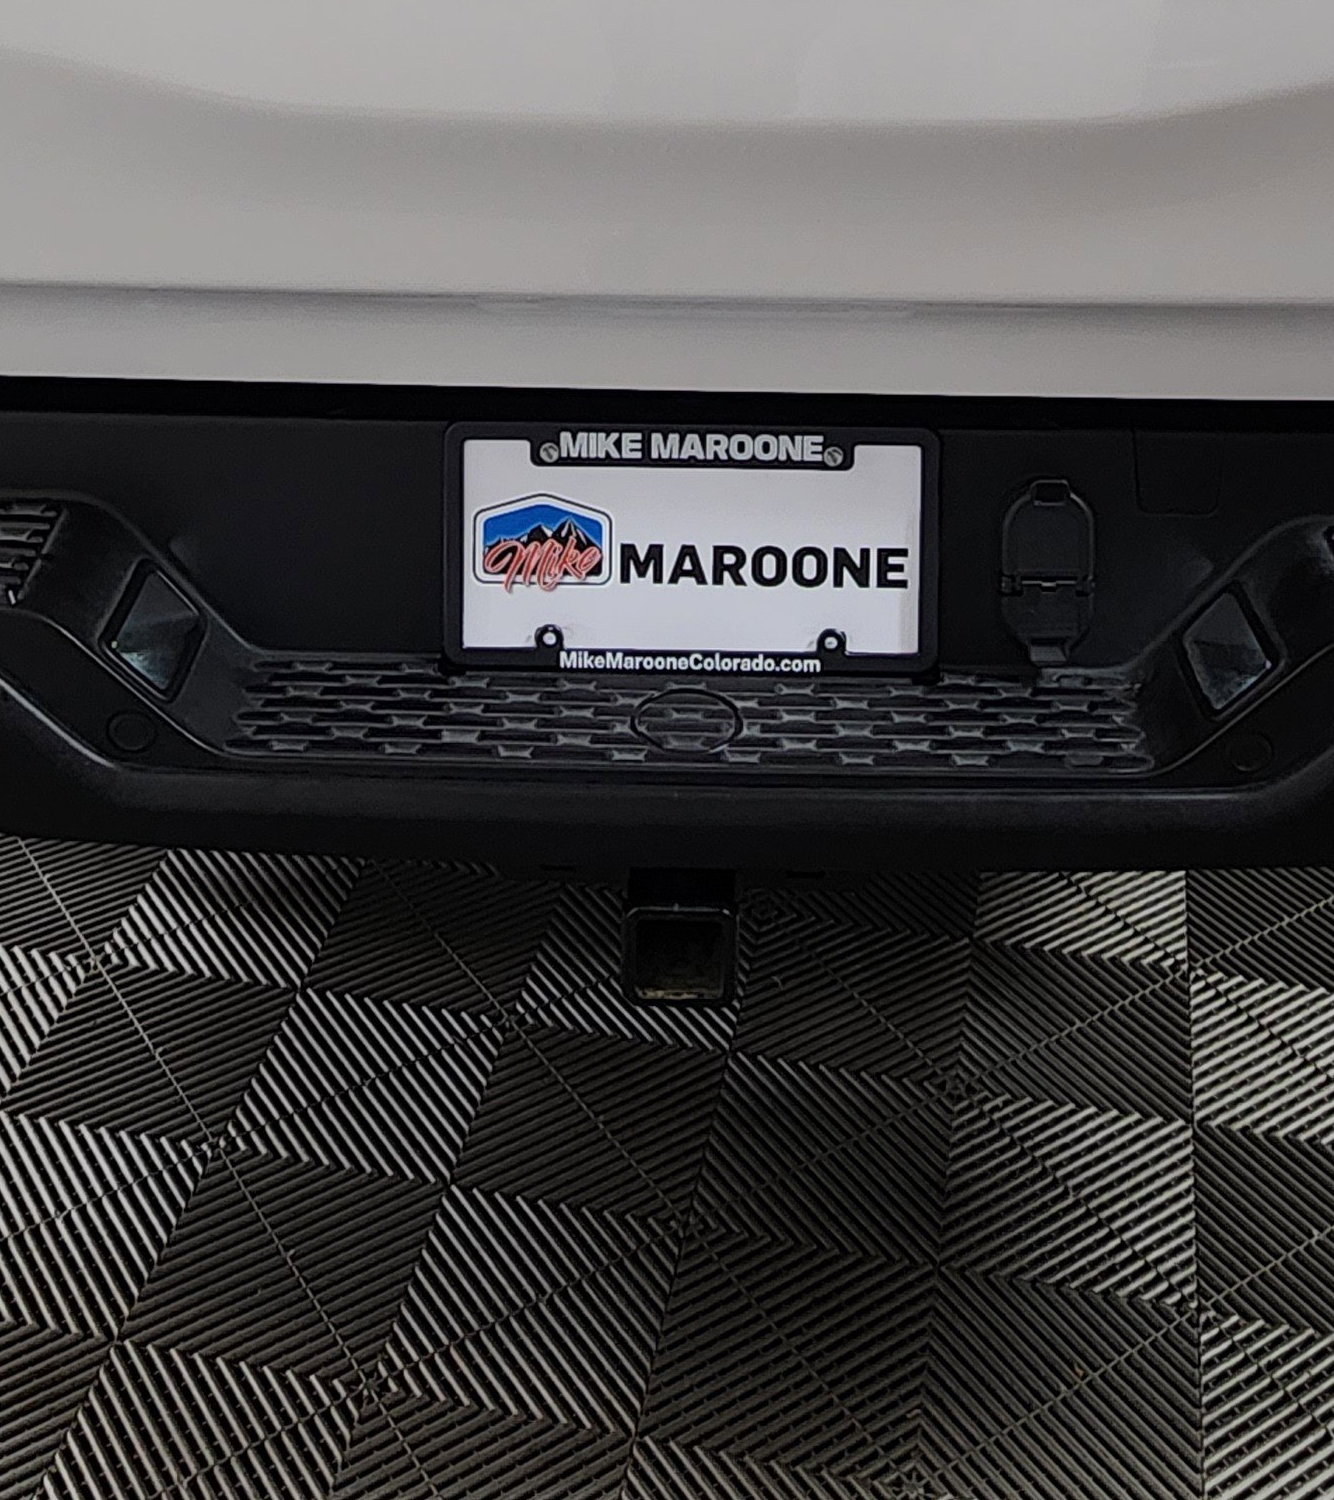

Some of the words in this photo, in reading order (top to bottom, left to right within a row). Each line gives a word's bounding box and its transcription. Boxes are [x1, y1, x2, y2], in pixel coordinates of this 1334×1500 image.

[559, 431, 642, 460] MIKE
[651, 434, 825, 462] MAROONE
[484, 536, 603, 593] Mike
[619, 543, 909, 589] MAROONE
[559, 651, 822, 674] MikeMarooneColorado.com
